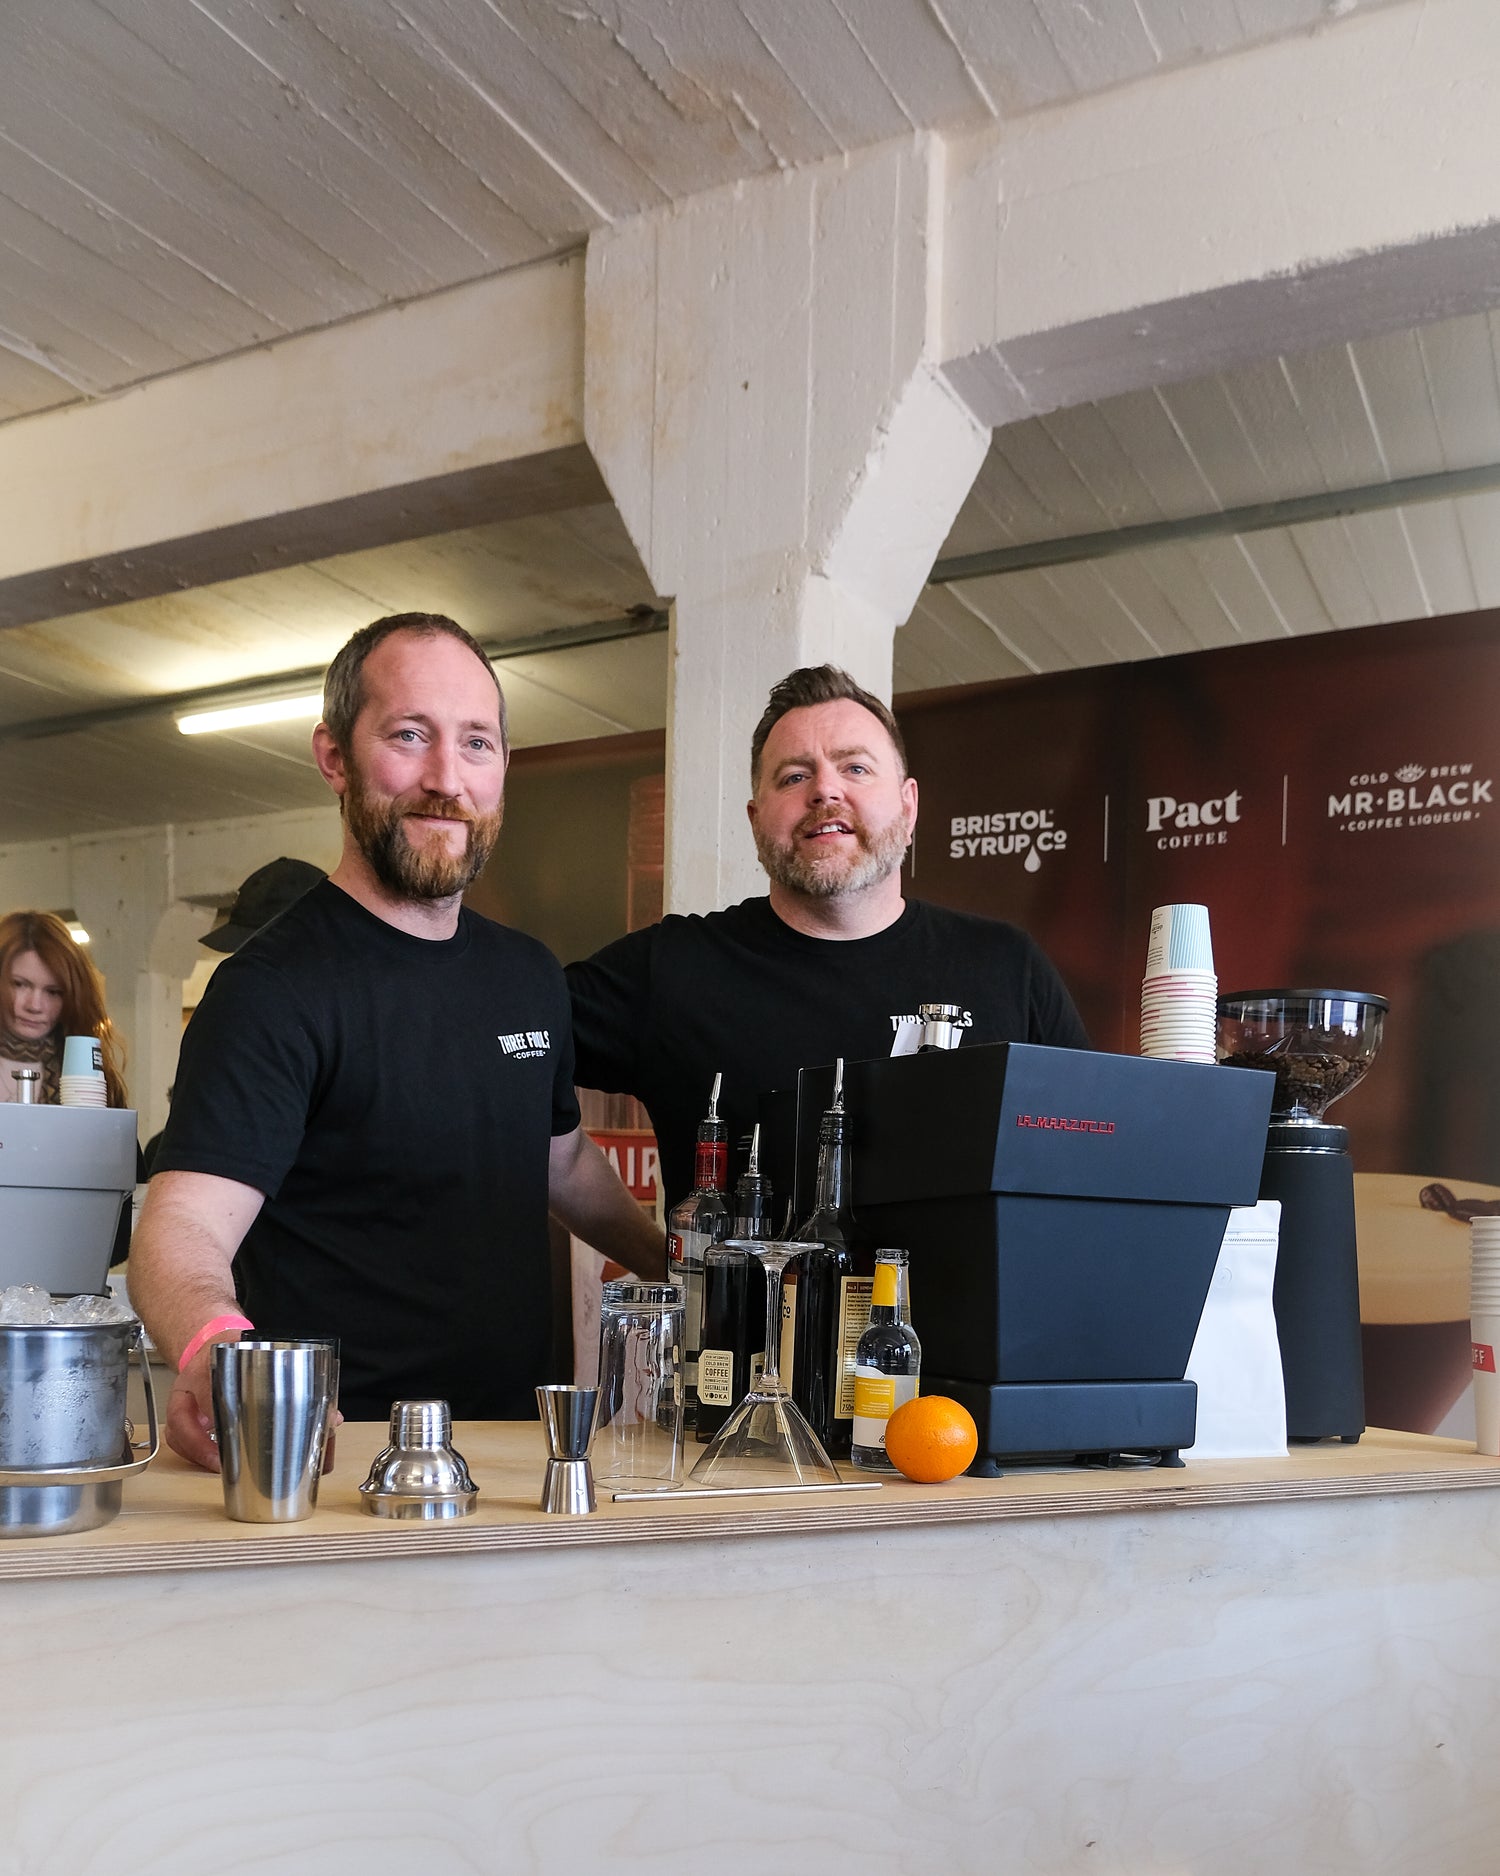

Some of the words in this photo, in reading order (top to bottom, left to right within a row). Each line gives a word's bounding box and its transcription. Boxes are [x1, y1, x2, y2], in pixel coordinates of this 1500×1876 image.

[1349, 772, 1389, 787] COLD
[1430, 763, 1473, 779] BREW
[950, 809, 1054, 836] BRISTOL
[1145, 789, 1242, 832] Pact
[949, 833, 1031, 858] SYRUP
[1157, 831, 1228, 850] COFFEE
[497, 1033, 528, 1055] THREE
[525, 1030, 551, 1050] FOOLS
[704, 1367, 729, 1378] COFFEE
[704, 1391, 729, 1400] VODKA
